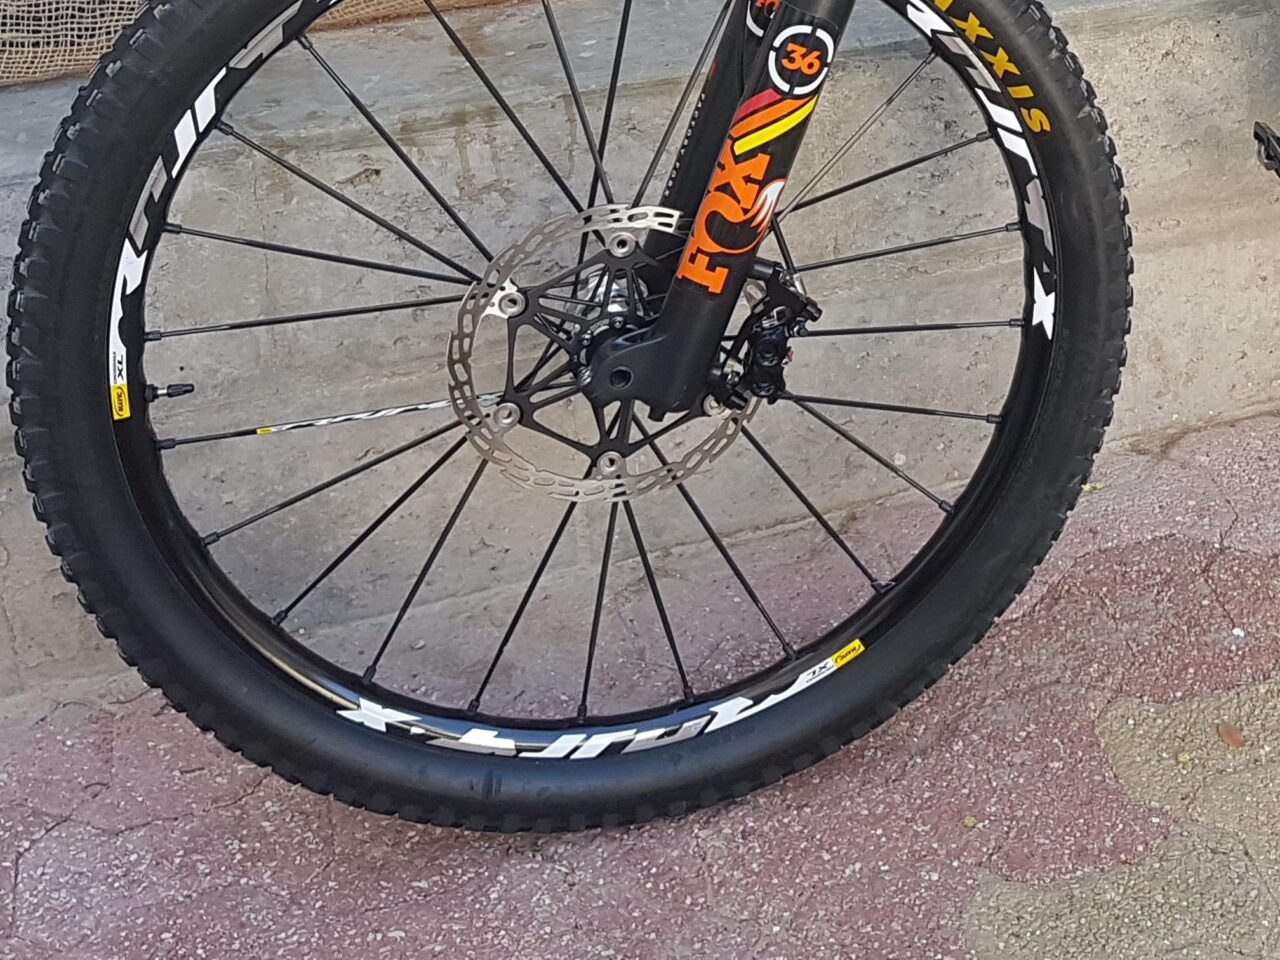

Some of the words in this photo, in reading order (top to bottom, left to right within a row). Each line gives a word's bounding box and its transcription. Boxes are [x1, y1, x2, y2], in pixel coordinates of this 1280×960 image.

[781, 41, 822, 76] 36
[681, 92, 706, 155] FACTORY
[676, 140, 787, 294] FOX
[117, 354, 124, 382] XL
[116, 391, 124, 412] MAVIC
[806, 661, 830, 677] XL
